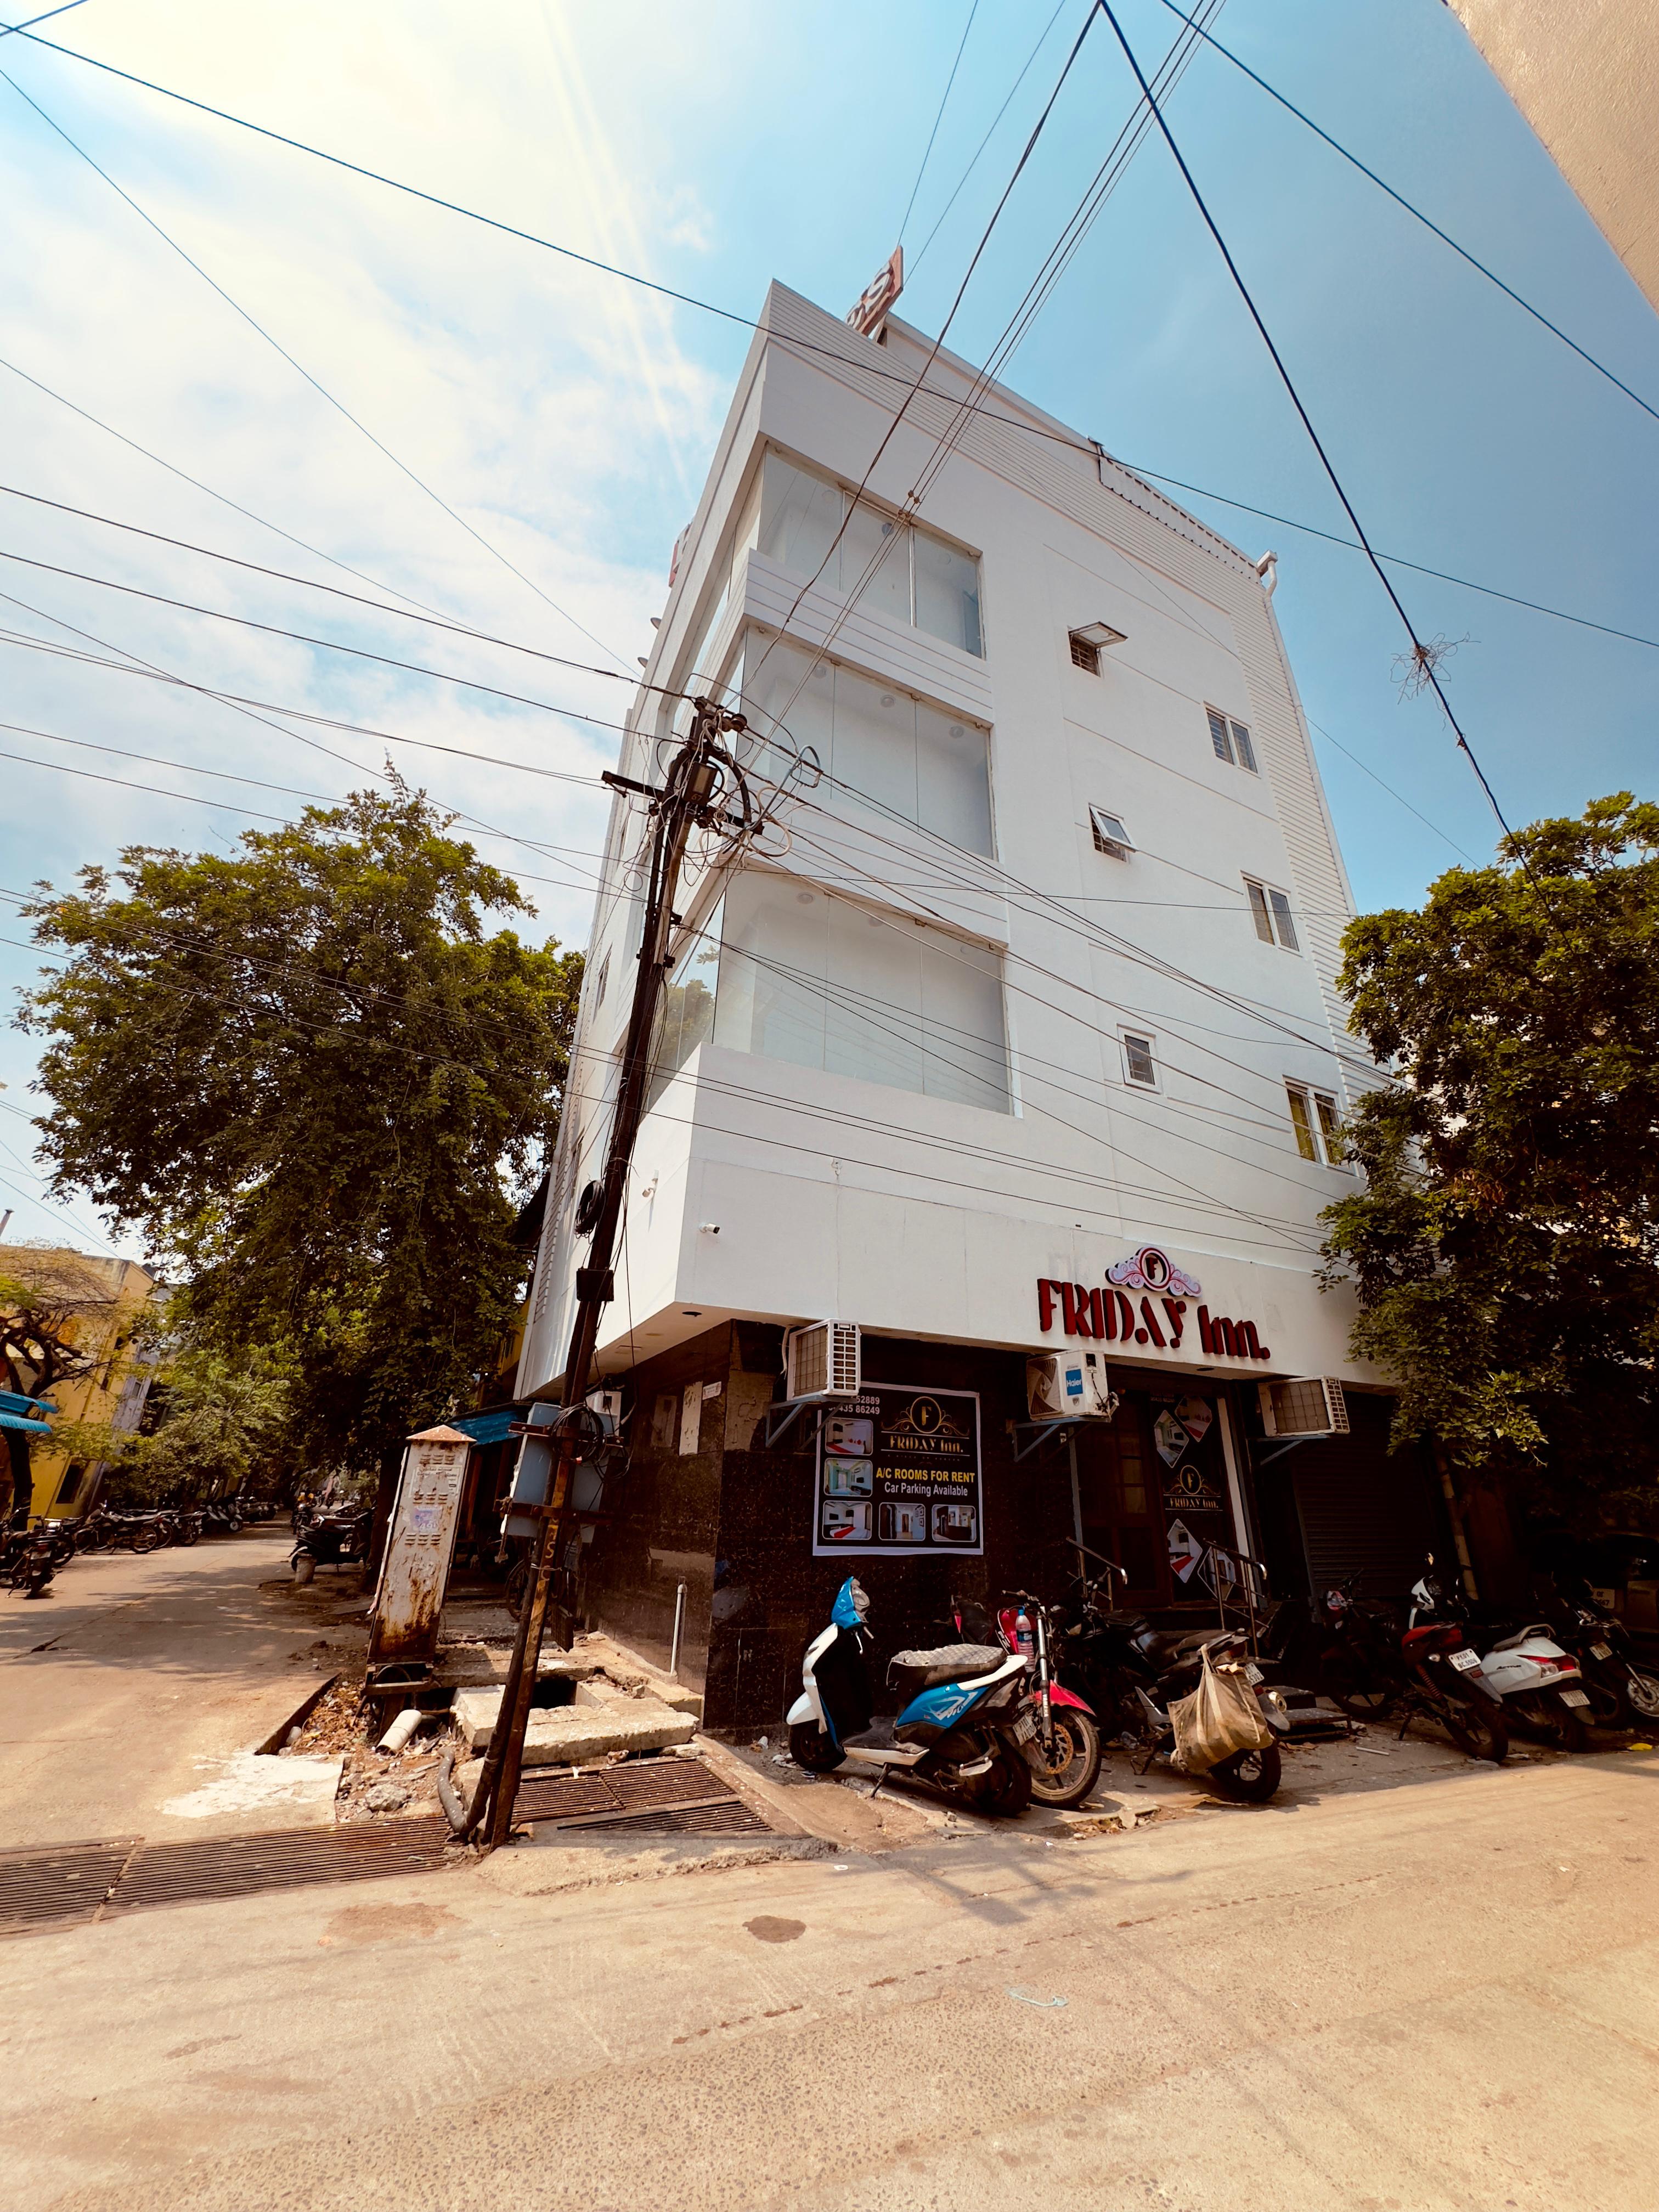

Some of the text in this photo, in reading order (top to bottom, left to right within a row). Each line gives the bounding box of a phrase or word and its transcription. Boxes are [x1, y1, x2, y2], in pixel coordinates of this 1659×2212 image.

[1146, 1256, 1159, 1280] F
[1036, 1278, 1187, 1348] FRIDAY
[1066, 1378, 1082, 1387] Haier
[855, 1405, 881, 1415] 86249
[921, 1406, 932, 1426] F
[890, 1435, 936, 1451] FRIDAY
[876, 1467, 975, 1483] A/C ROOMS FOR RENT
[884, 1481, 968, 1497] Car Parking Available
[1169, 1497, 1201, 1508] FRIDAY
